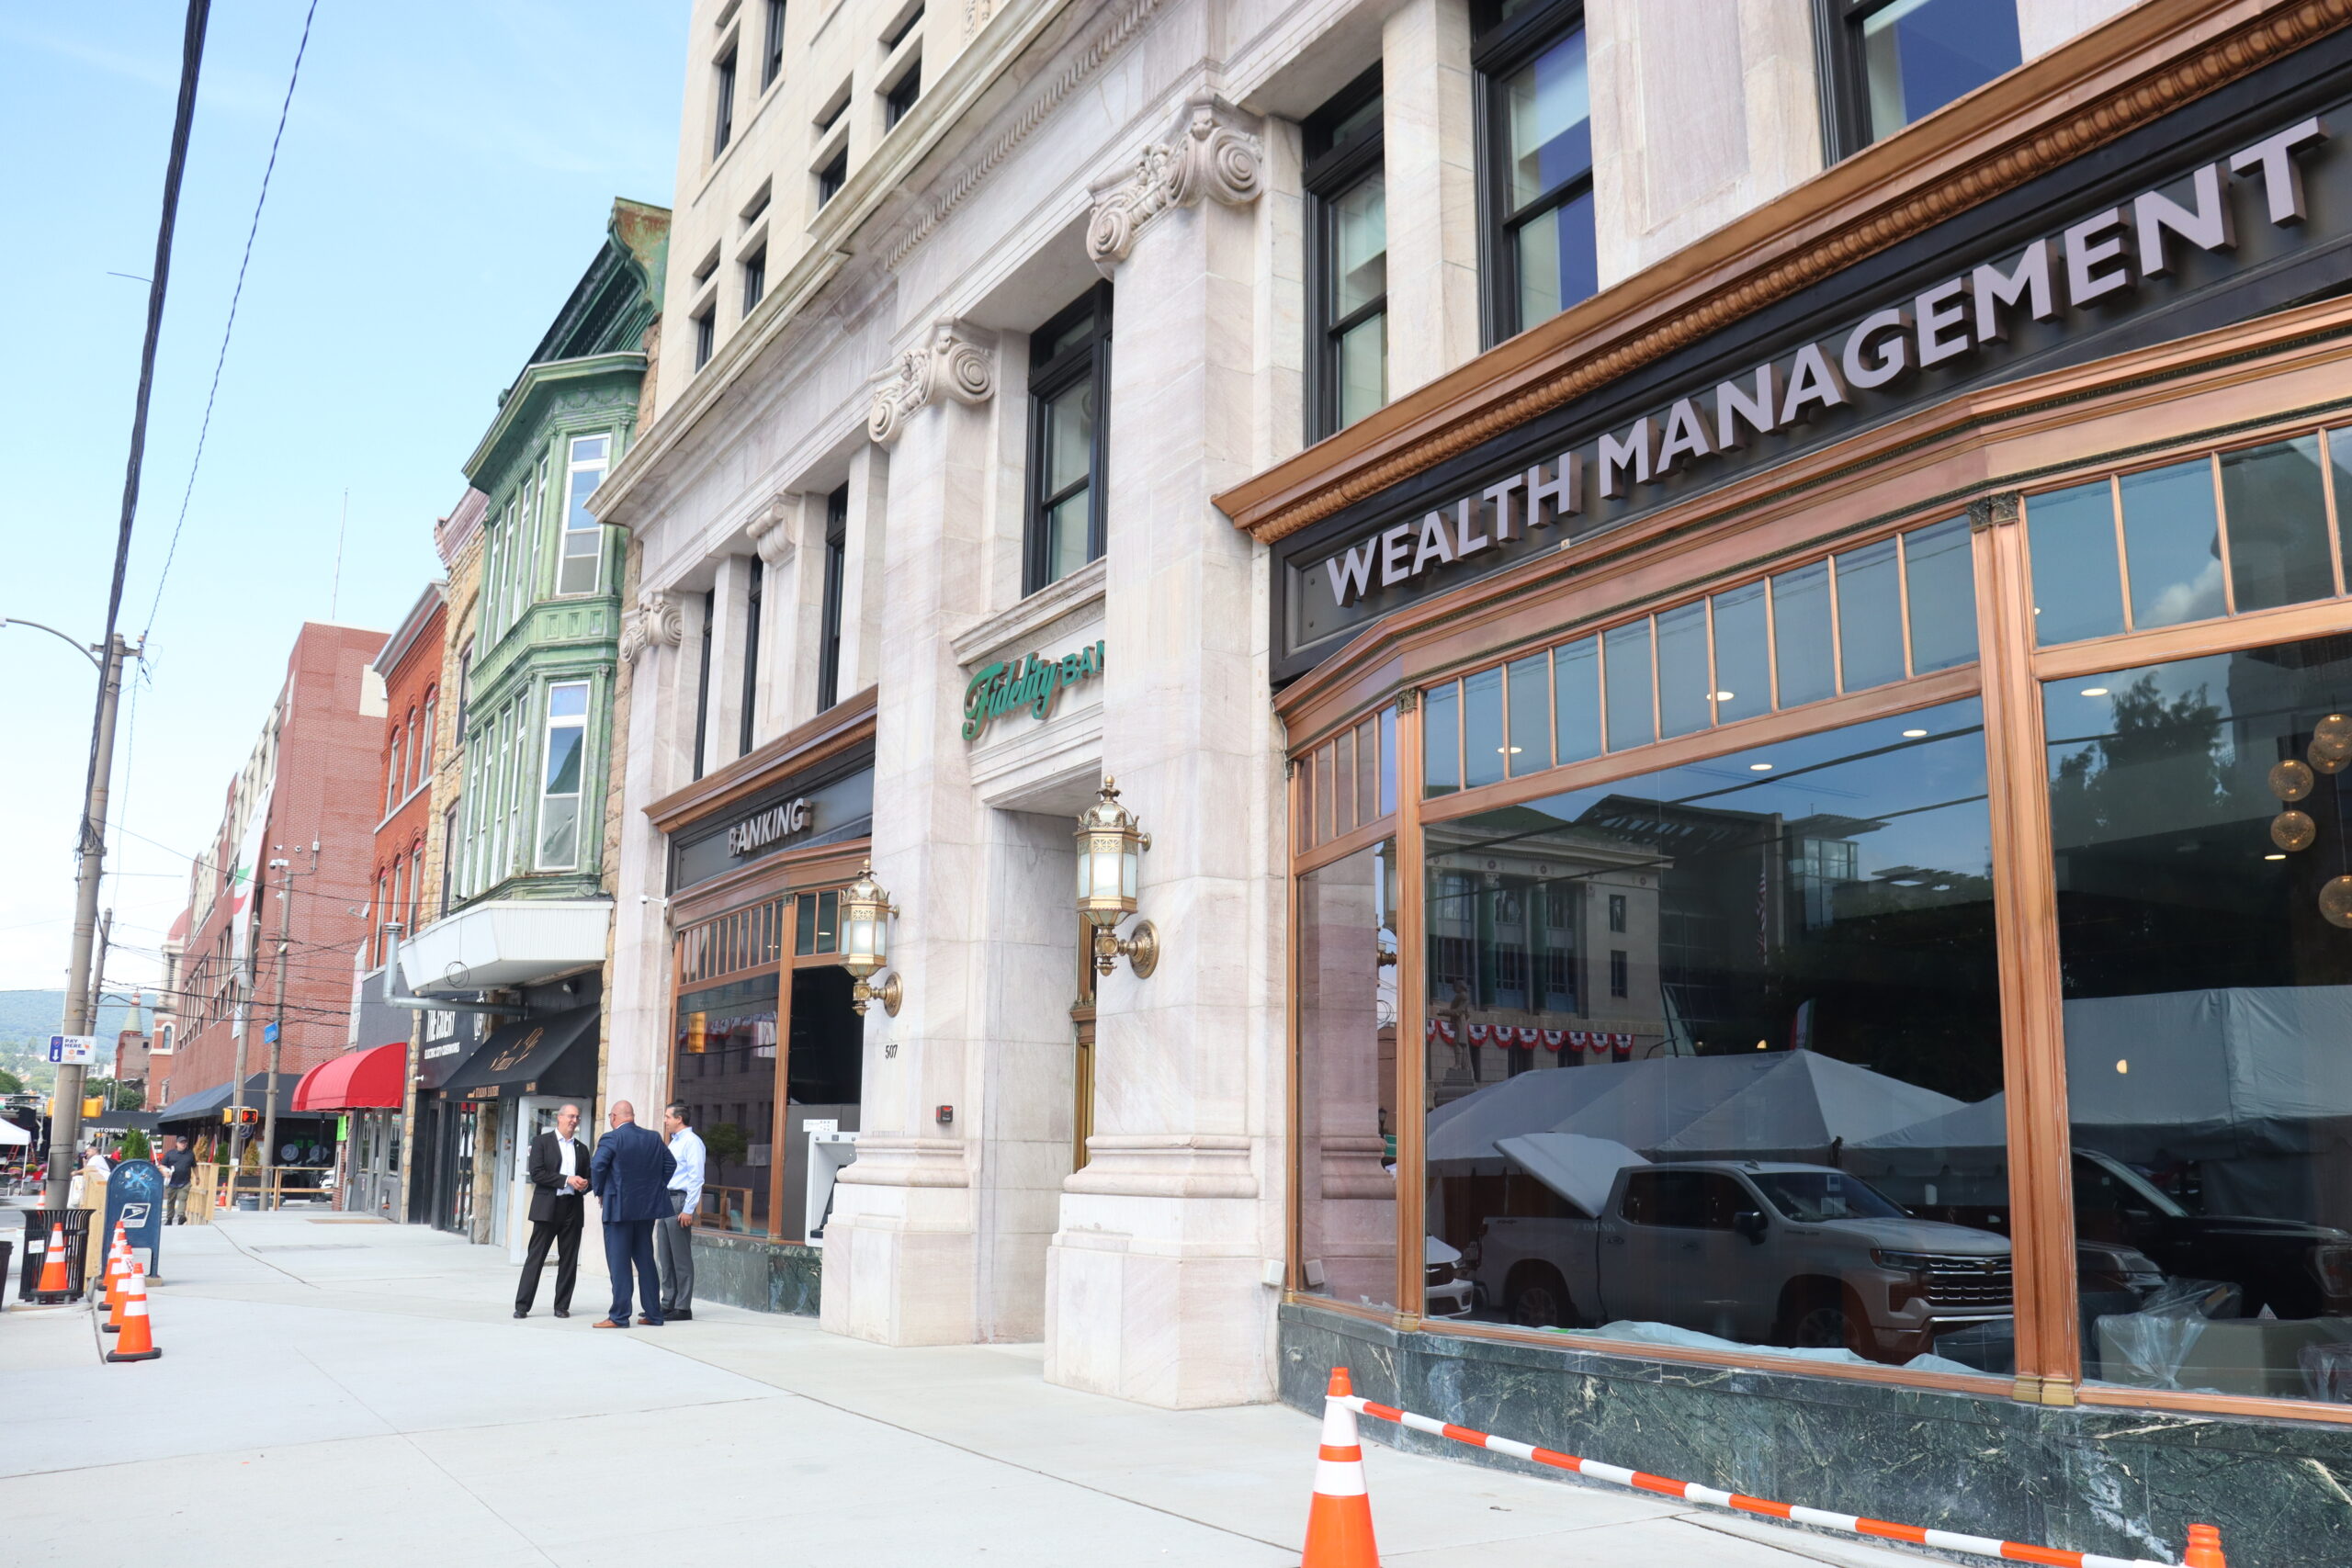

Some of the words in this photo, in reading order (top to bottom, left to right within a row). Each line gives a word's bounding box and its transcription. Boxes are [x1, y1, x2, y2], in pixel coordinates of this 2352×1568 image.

[1326, 451, 1578, 608] WEALTH
[1599, 116, 2324, 501] MANAGEMENT
[961, 651, 1059, 741] Fidelity
[1062, 639, 1105, 688] BAN
[729, 796, 808, 858] BANKING
[885, 1043, 899, 1059] 507
